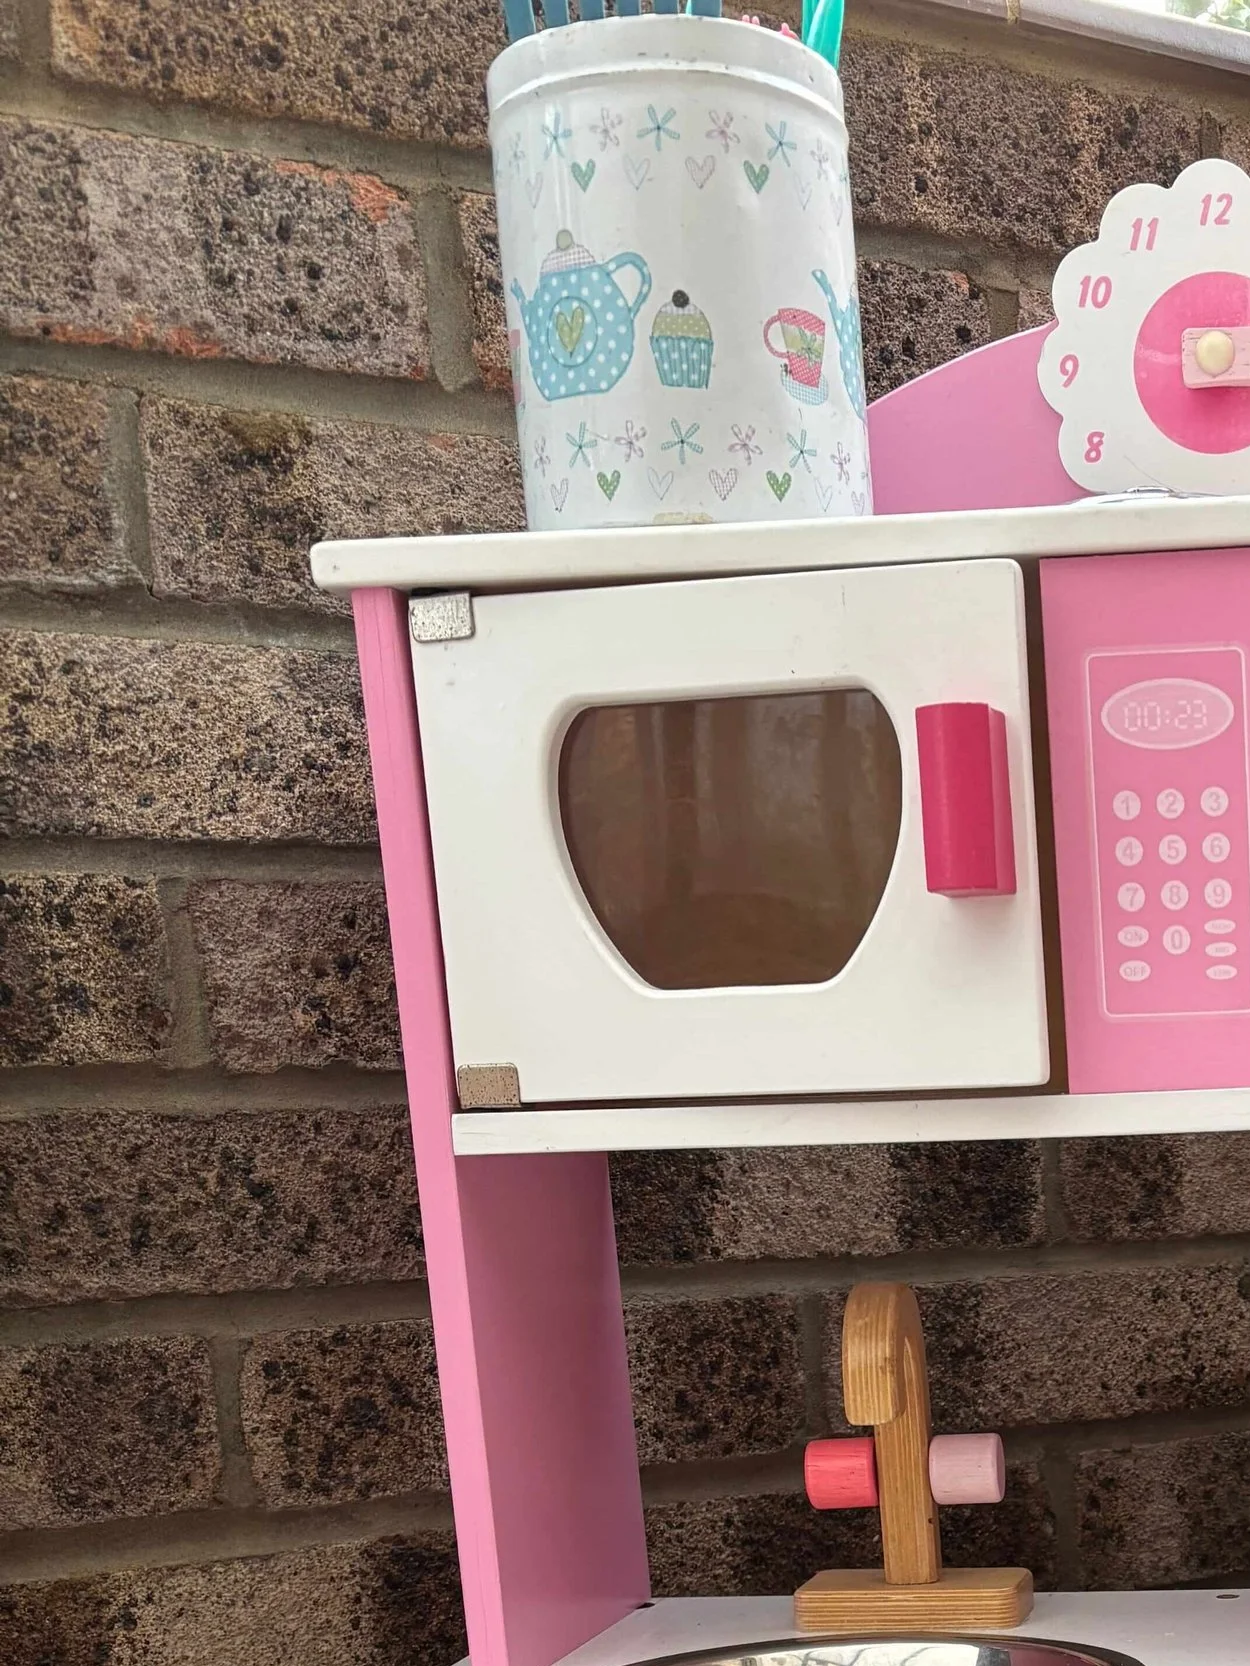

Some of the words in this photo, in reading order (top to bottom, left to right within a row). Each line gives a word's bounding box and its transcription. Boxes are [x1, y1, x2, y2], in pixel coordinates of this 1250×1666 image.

[1200, 193, 1233, 226] 12
[1129, 217, 1160, 251] 11
[1078, 275, 1113, 309] 10
[1059, 354, 1079, 388] 9
[1084, 431, 1105, 463] 8
[1165, 792, 1178, 813] 2
[1208, 791, 1221, 812] 3
[1121, 841, 1135, 861] 4
[1167, 839, 1180, 860] 5
[1210, 837, 1223, 857] 6
[1125, 887, 1139, 907] 7
[1169, 884, 1181, 905] 8
[1212, 884, 1225, 904] 9
[1171, 929, 1183, 951] 0
[1123, 966, 1146, 977] OFF
